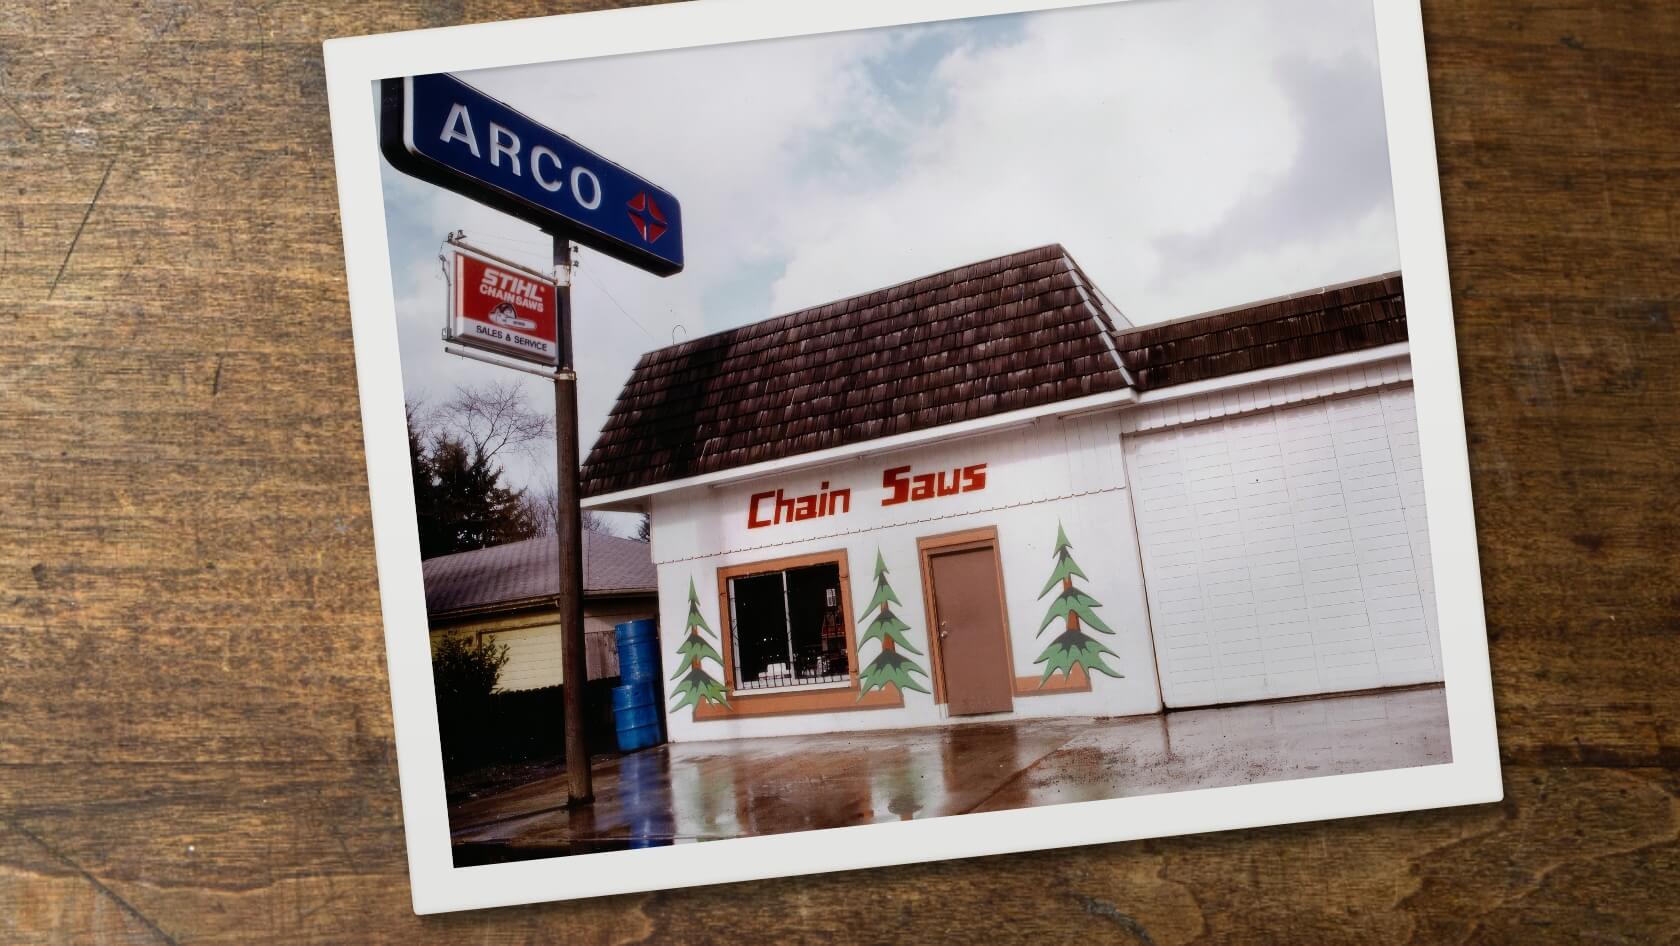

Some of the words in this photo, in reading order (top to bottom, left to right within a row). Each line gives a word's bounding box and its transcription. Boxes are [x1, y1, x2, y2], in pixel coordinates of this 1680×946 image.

[440, 102, 602, 210] ARCO
[482, 267, 542, 302] STIHL
[476, 325, 503, 340] SALES
[505, 333, 513, 342] &
[514, 335, 548, 352] SERVICE
[747, 481, 851, 529] Chain
[881, 463, 987, 506] Saws
